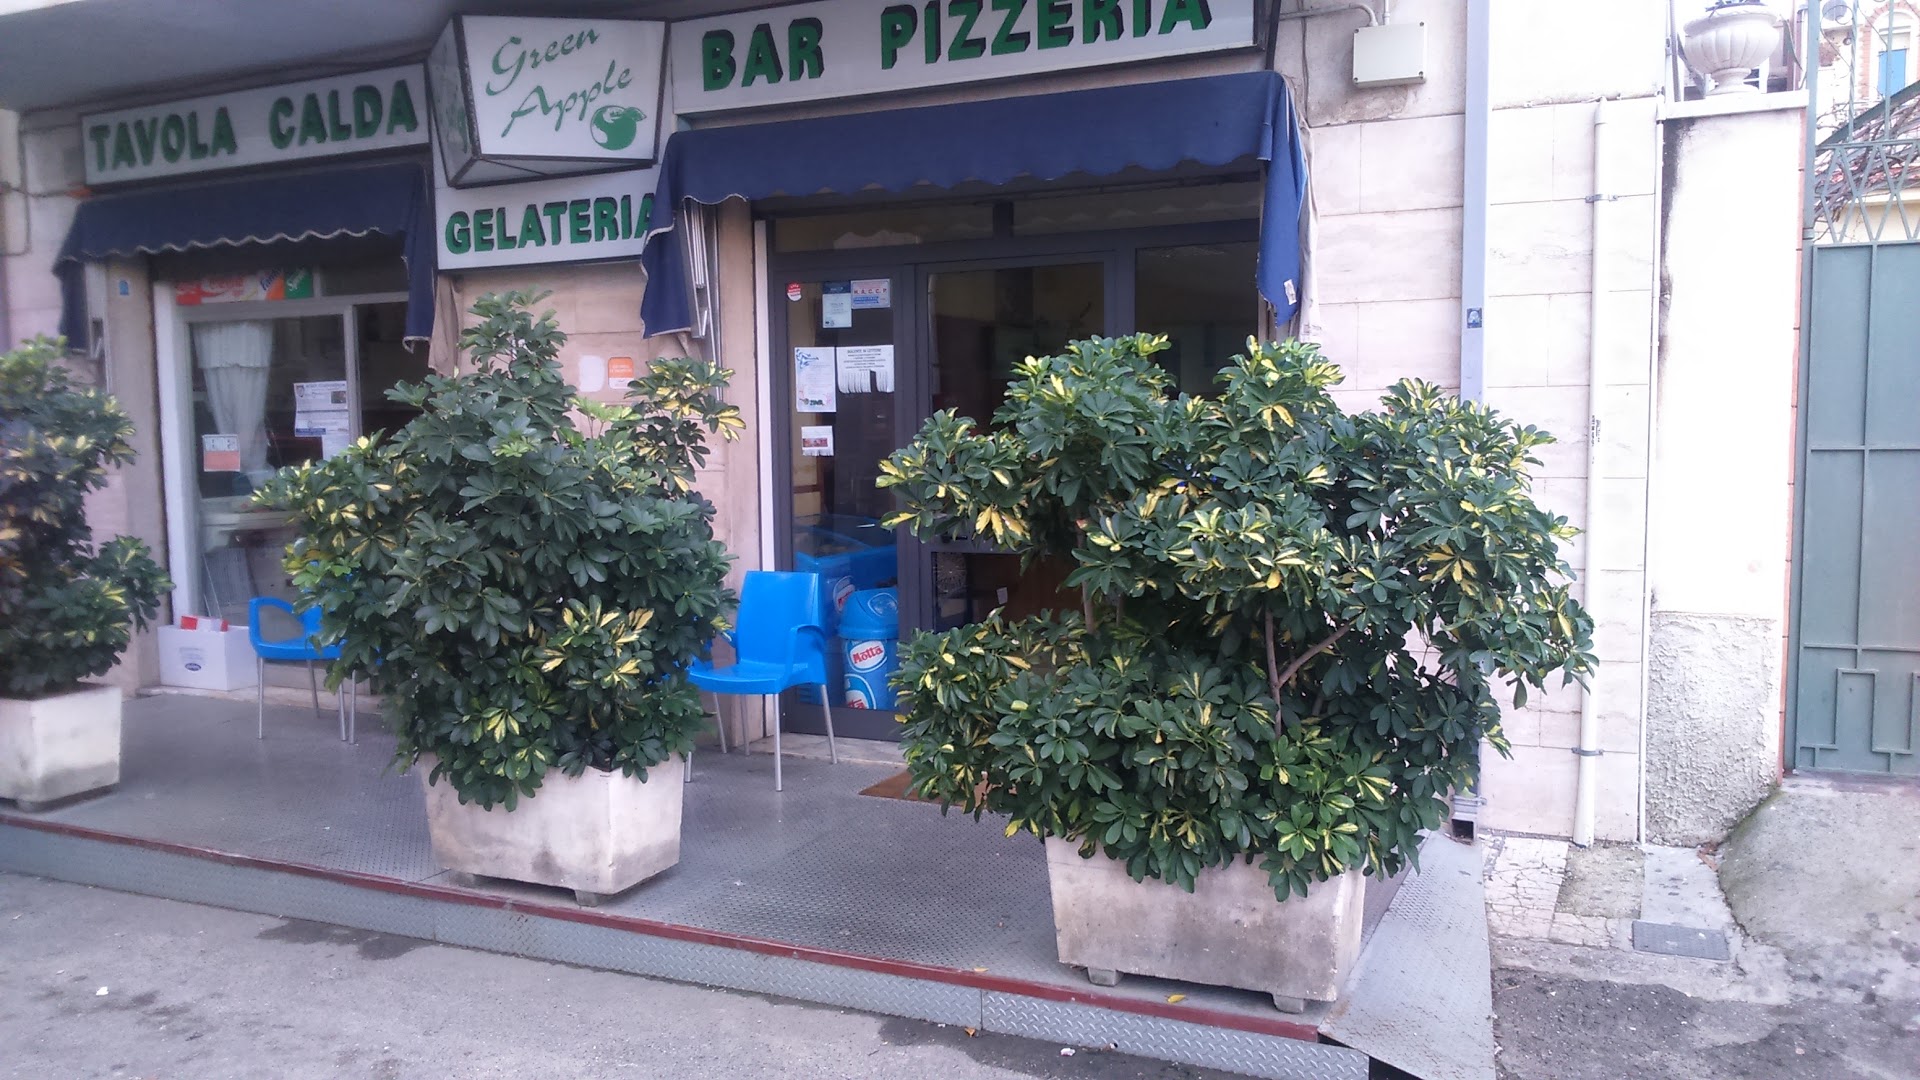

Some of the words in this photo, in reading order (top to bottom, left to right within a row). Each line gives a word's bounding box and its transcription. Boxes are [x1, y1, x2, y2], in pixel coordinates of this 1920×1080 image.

[485, 28, 600, 96] Green
[703, 18, 825, 92] BAR
[881, 0, 1213, 70] PIZZERIA
[89, 106, 238, 172] TAVOLA
[268, 79, 418, 149] CALDA
[501, 59, 632, 138] Apple
[852, 645, 884, 665] Motta
